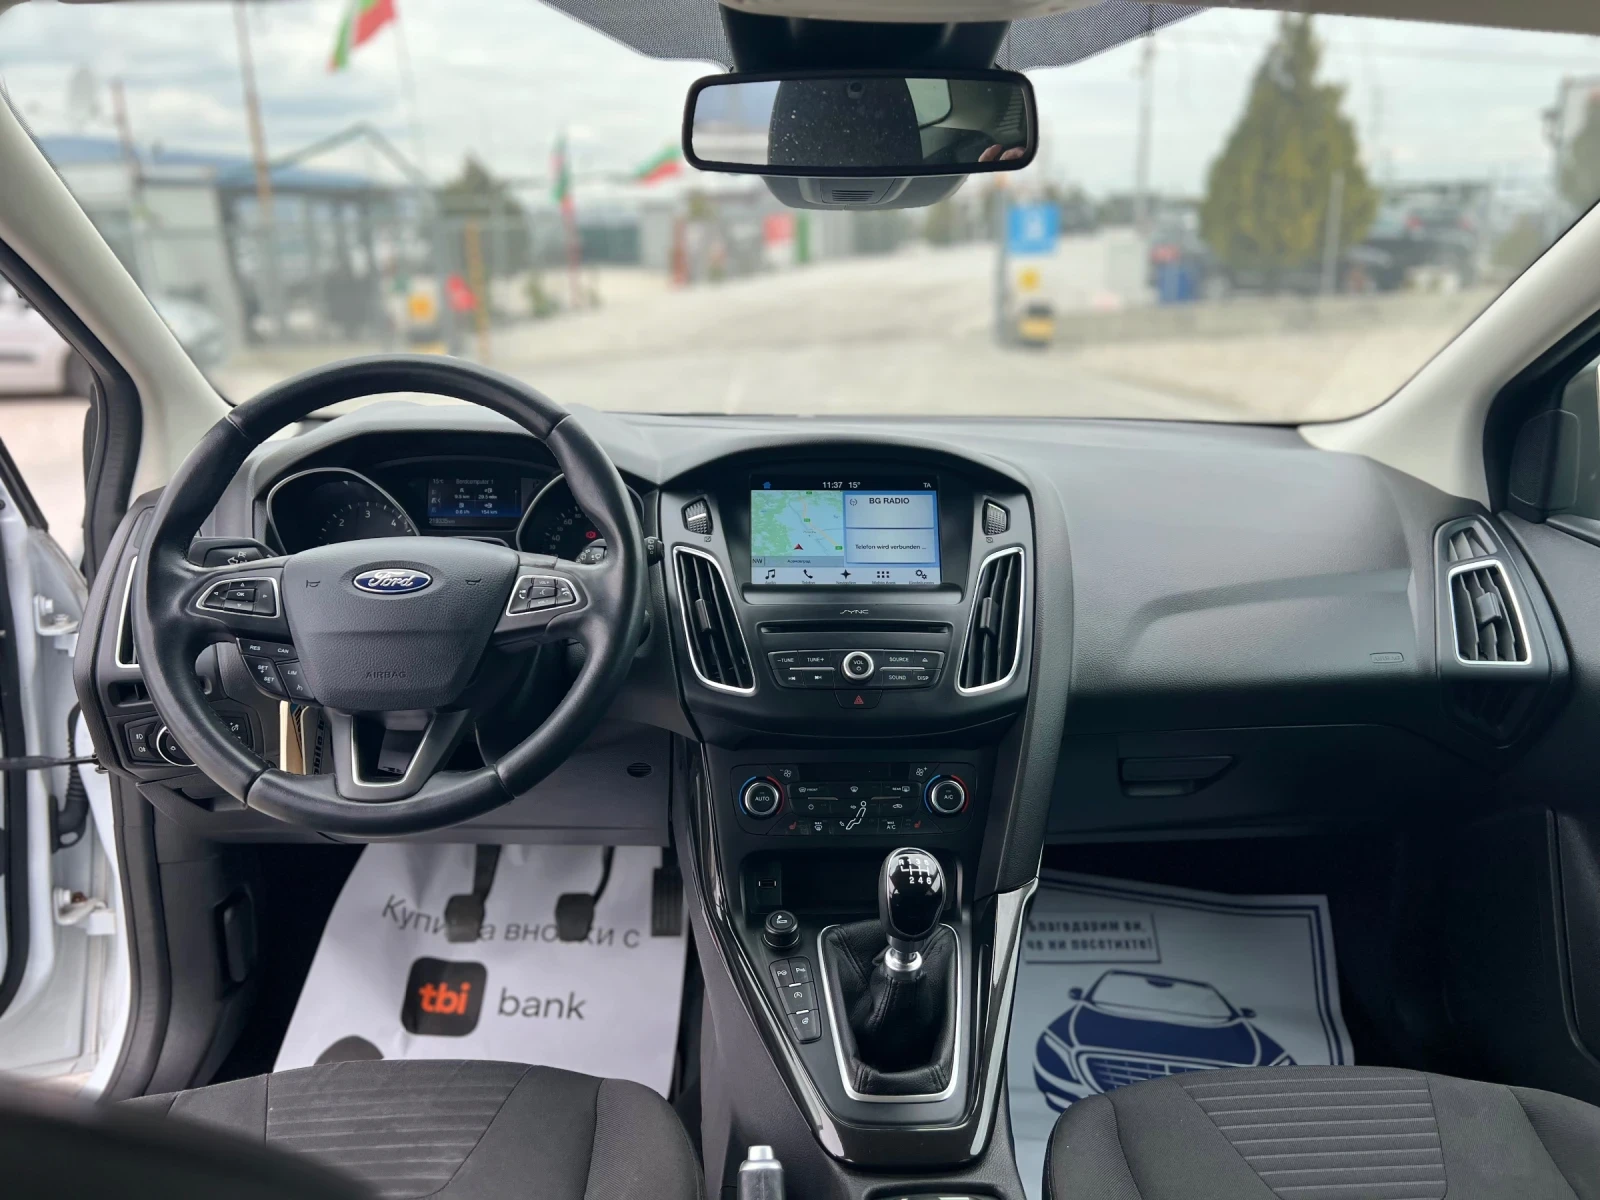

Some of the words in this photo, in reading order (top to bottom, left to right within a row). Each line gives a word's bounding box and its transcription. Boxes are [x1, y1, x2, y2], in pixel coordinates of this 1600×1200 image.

[822, 481, 843, 489] 11:37
[848, 481, 861, 489] 15°
[869, 497, 881, 505] BG
[883, 497, 910, 505] RADIO
[365, 510, 371, 518] 3
[339, 519, 345, 527] 2
[391, 519, 397, 527] 4
[563, 518, 573, 526] 60
[551, 534, 561, 542] 40
[367, 570, 414, 589] Ford
[365, 670, 407, 679] AIRBAG
[898, 858, 905, 866] R
[909, 876, 915, 884] 2
[917, 876, 924, 884] 4
[926, 876, 932, 885] 6
[418, 982, 471, 1015] tbi
[497, 986, 586, 1020] bank
